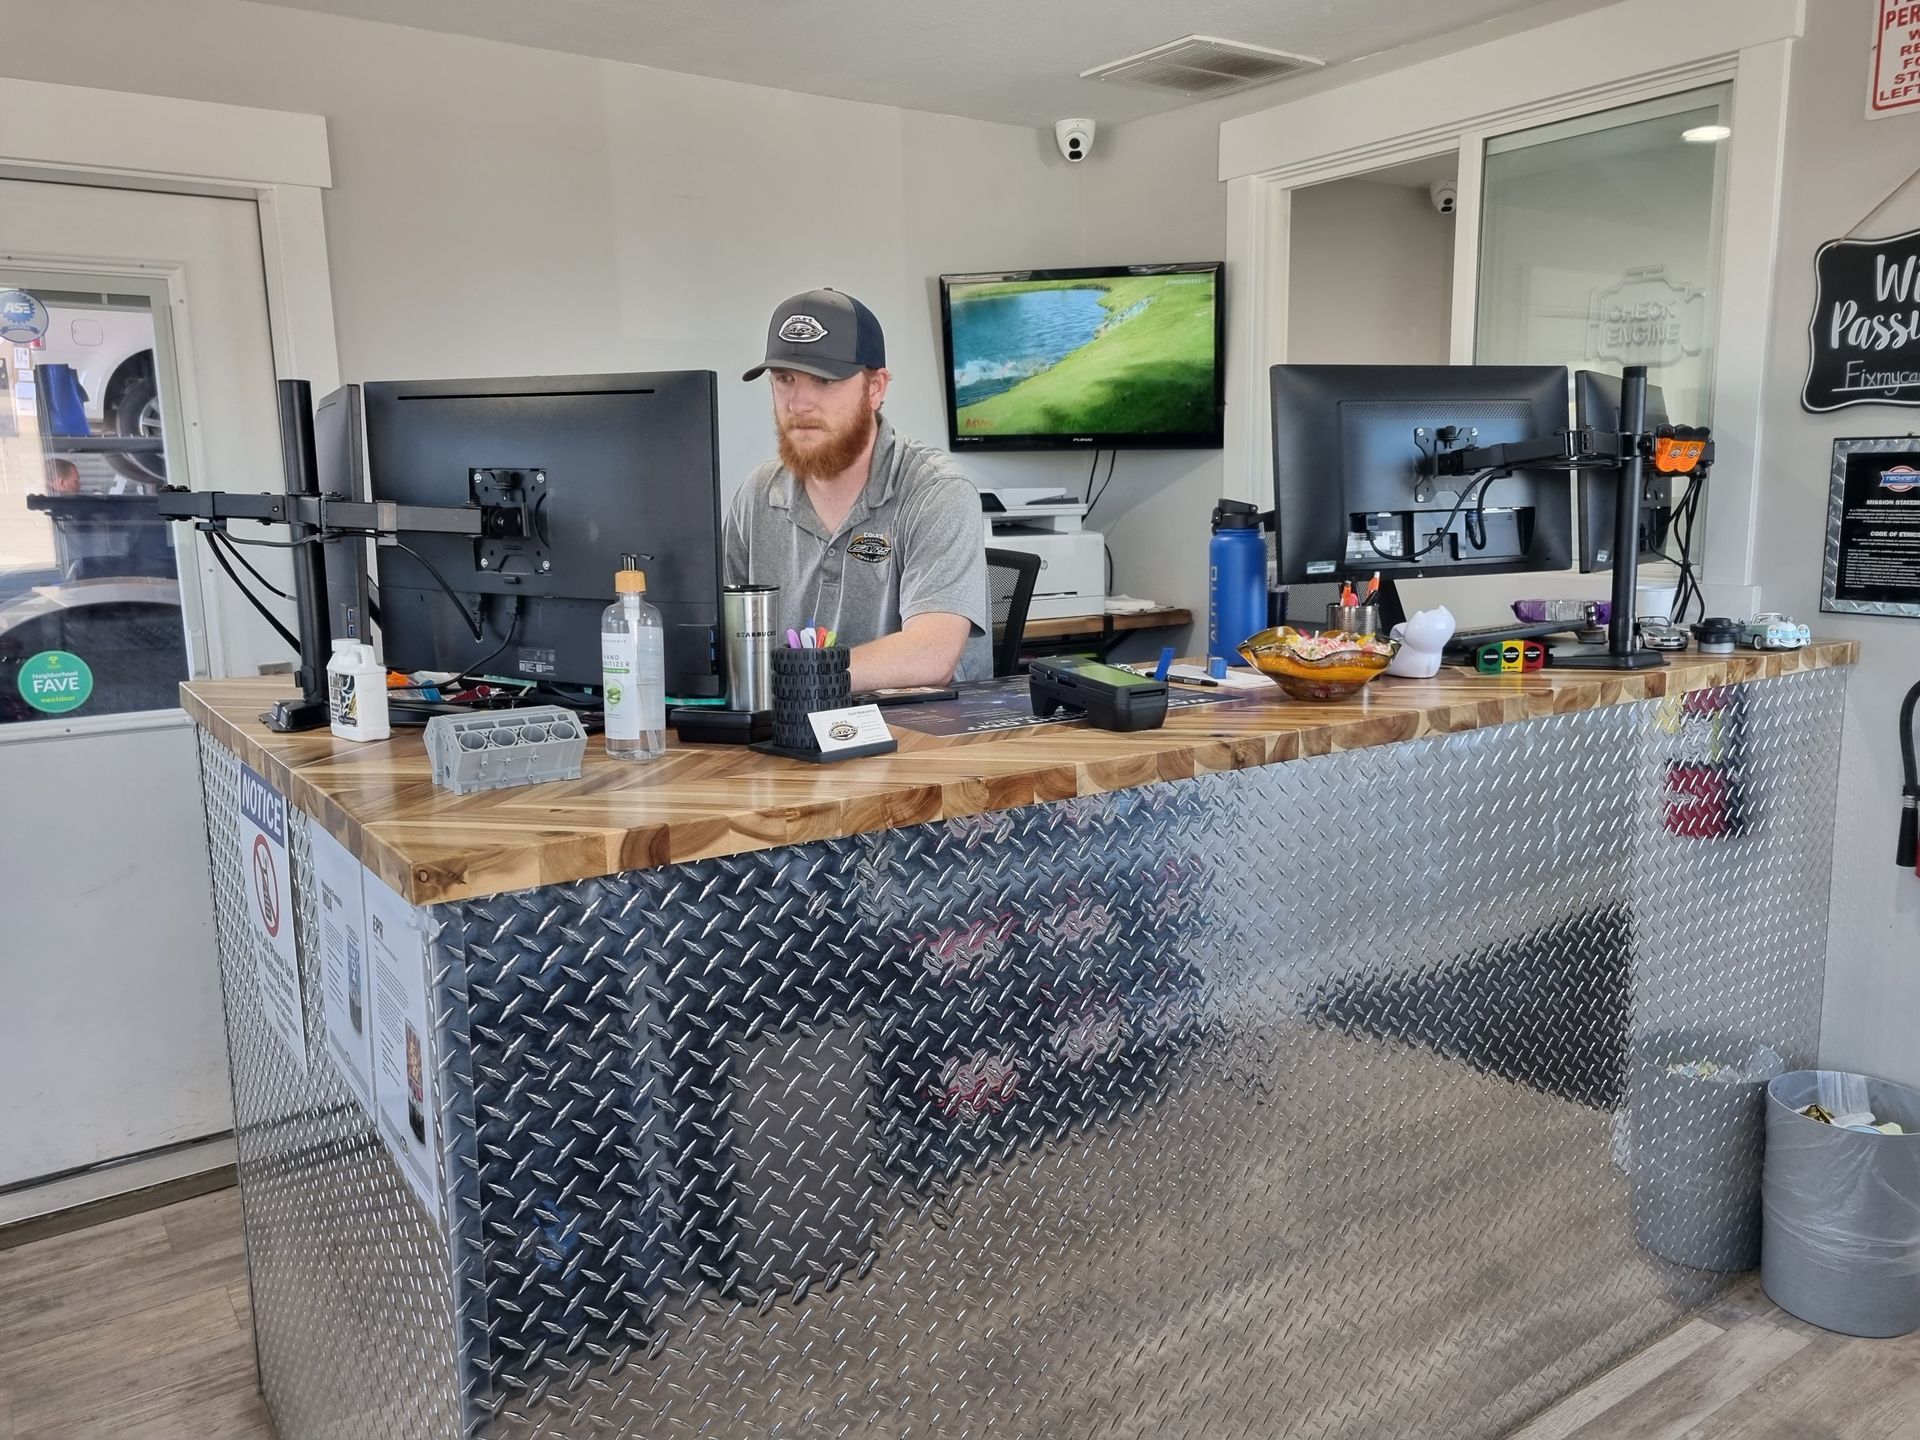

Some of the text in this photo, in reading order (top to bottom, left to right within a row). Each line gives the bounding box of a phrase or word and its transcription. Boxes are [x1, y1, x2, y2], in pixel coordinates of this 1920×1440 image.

[1894, 70, 1920, 85] ST
[4, 303, 31, 314] ASE
[1609, 300, 1677, 323] CHECK
[1607, 323, 1681, 348] ENGINE
[735, 630, 777, 638] STARBUCKS
[32, 671, 79, 679] Neighborhood
[33, 677, 80, 693] FAVE
[242, 772, 282, 837] NOTICE
[372, 913, 384, 941] EPR
